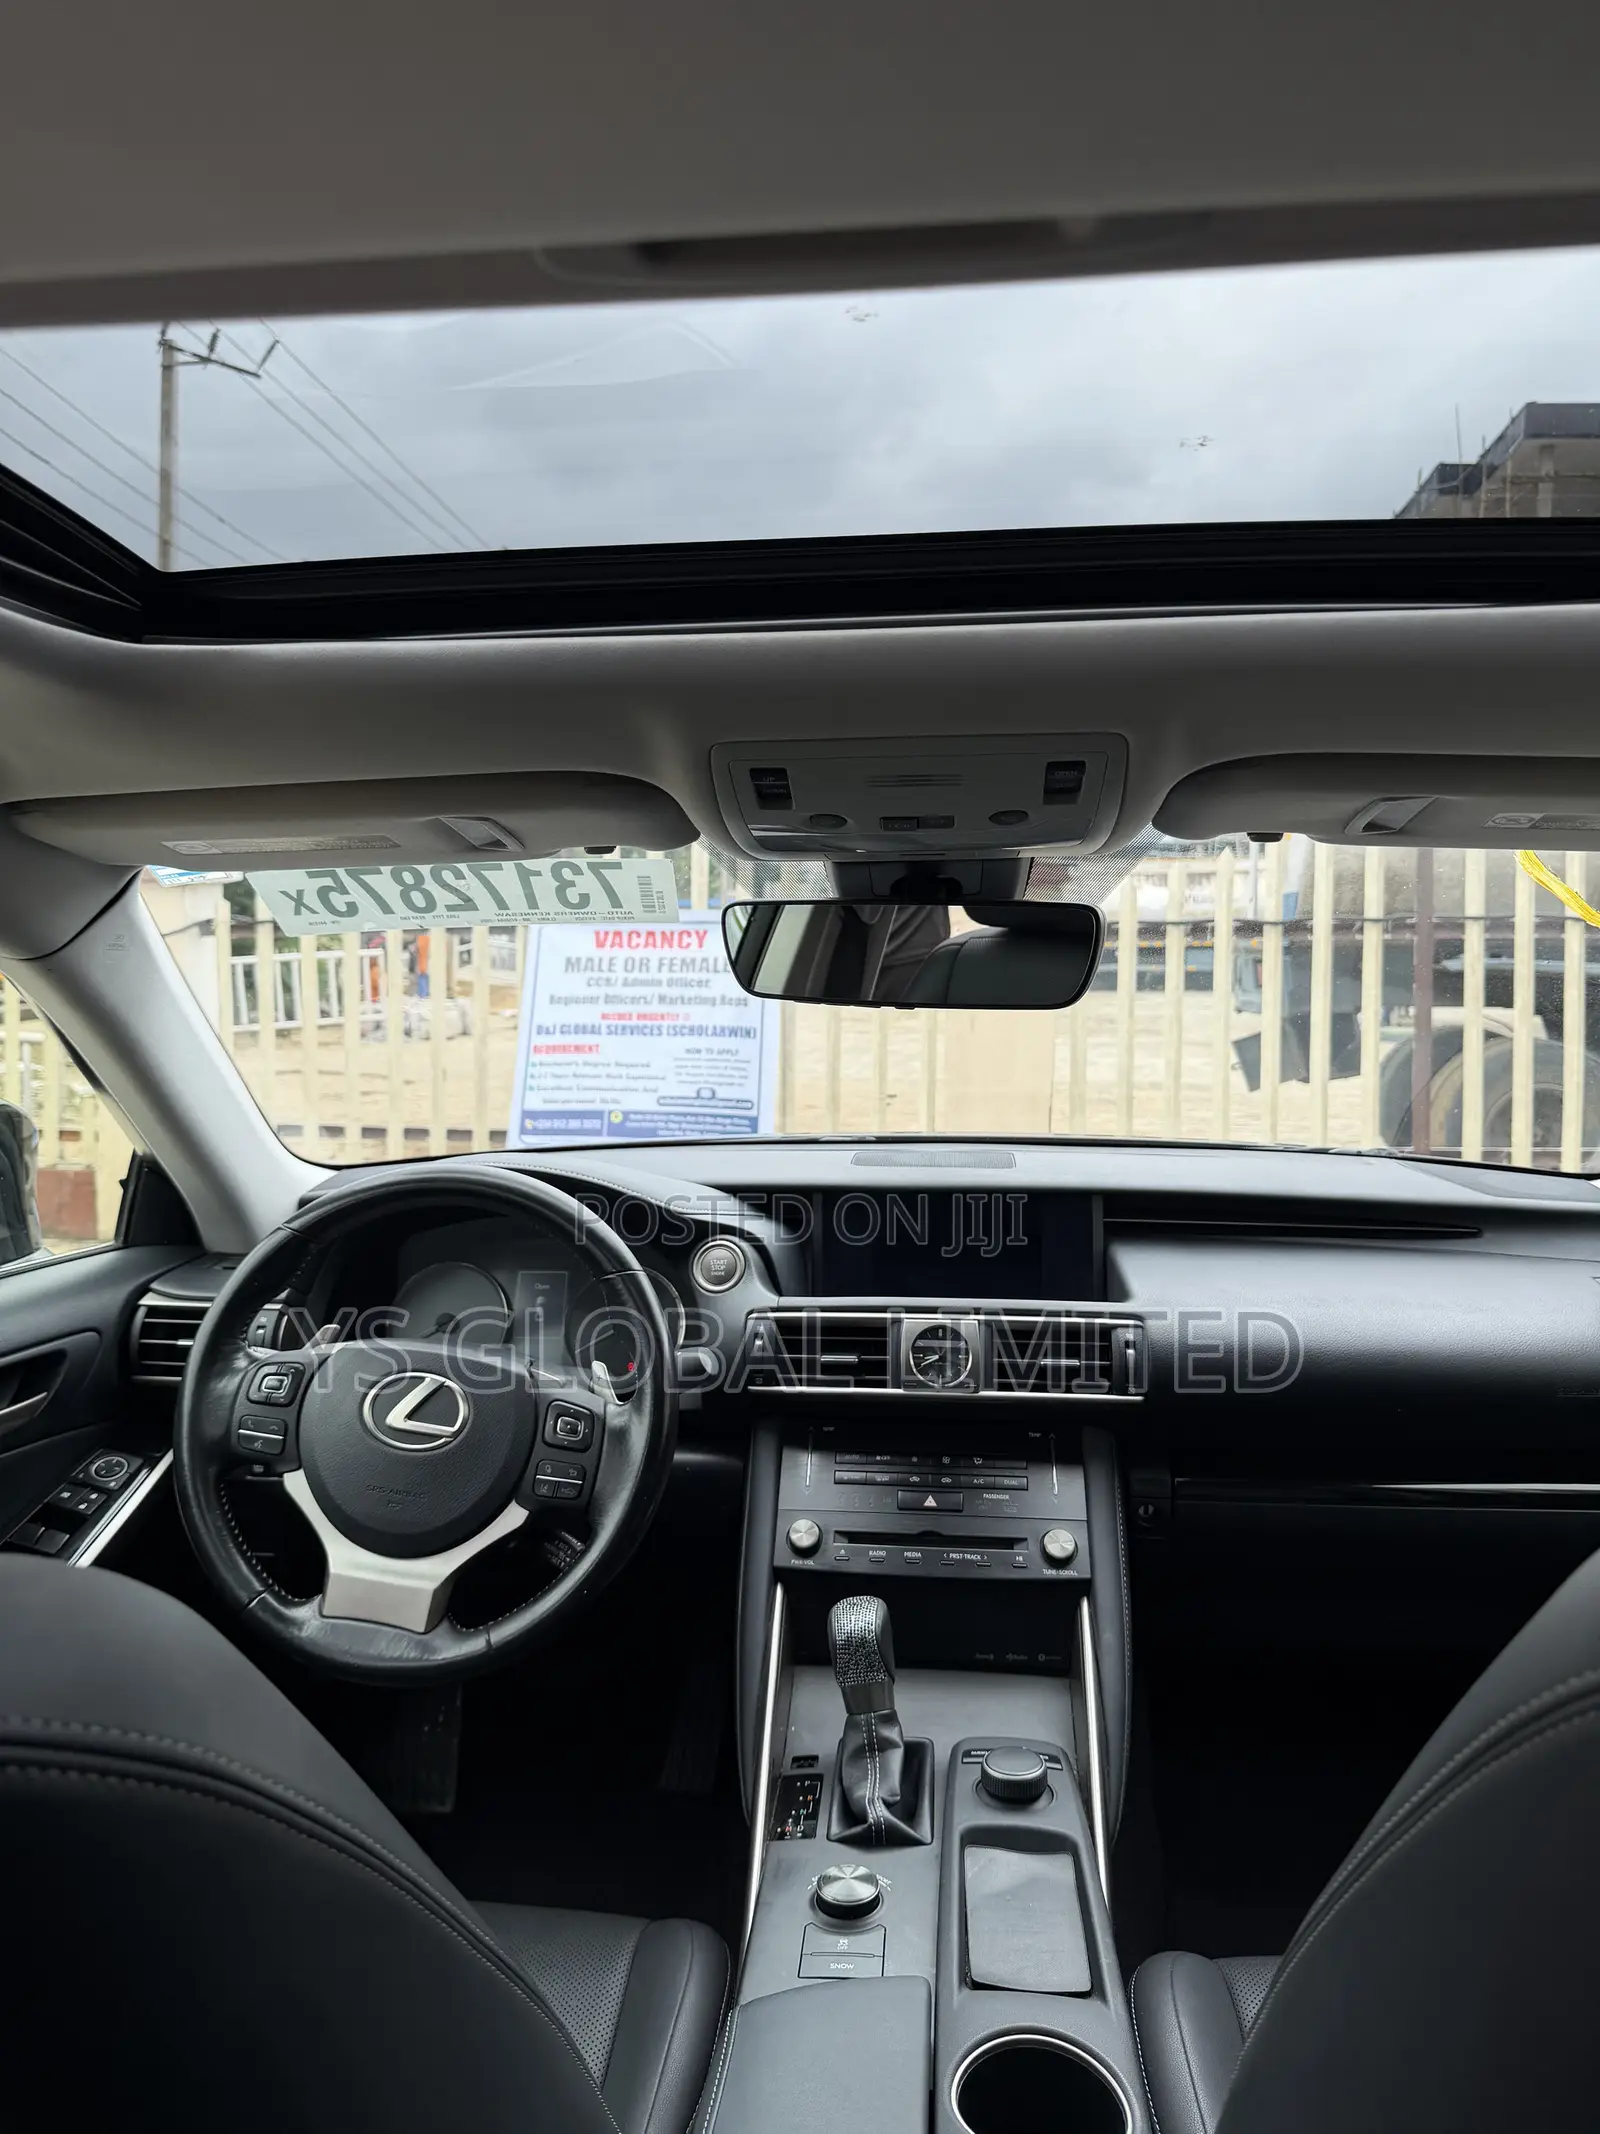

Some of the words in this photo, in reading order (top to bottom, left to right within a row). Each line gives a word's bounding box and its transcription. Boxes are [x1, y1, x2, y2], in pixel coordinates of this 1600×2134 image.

[593, 929, 709, 950] VACANCY
[564, 956, 618, 973] MALE
[623, 956, 651, 973] OR
[559, 1024, 602, 1037] GLOBAL
[606, 1024, 664, 1037] SERVICES
[829, 1962, 855, 1970] SNOW
